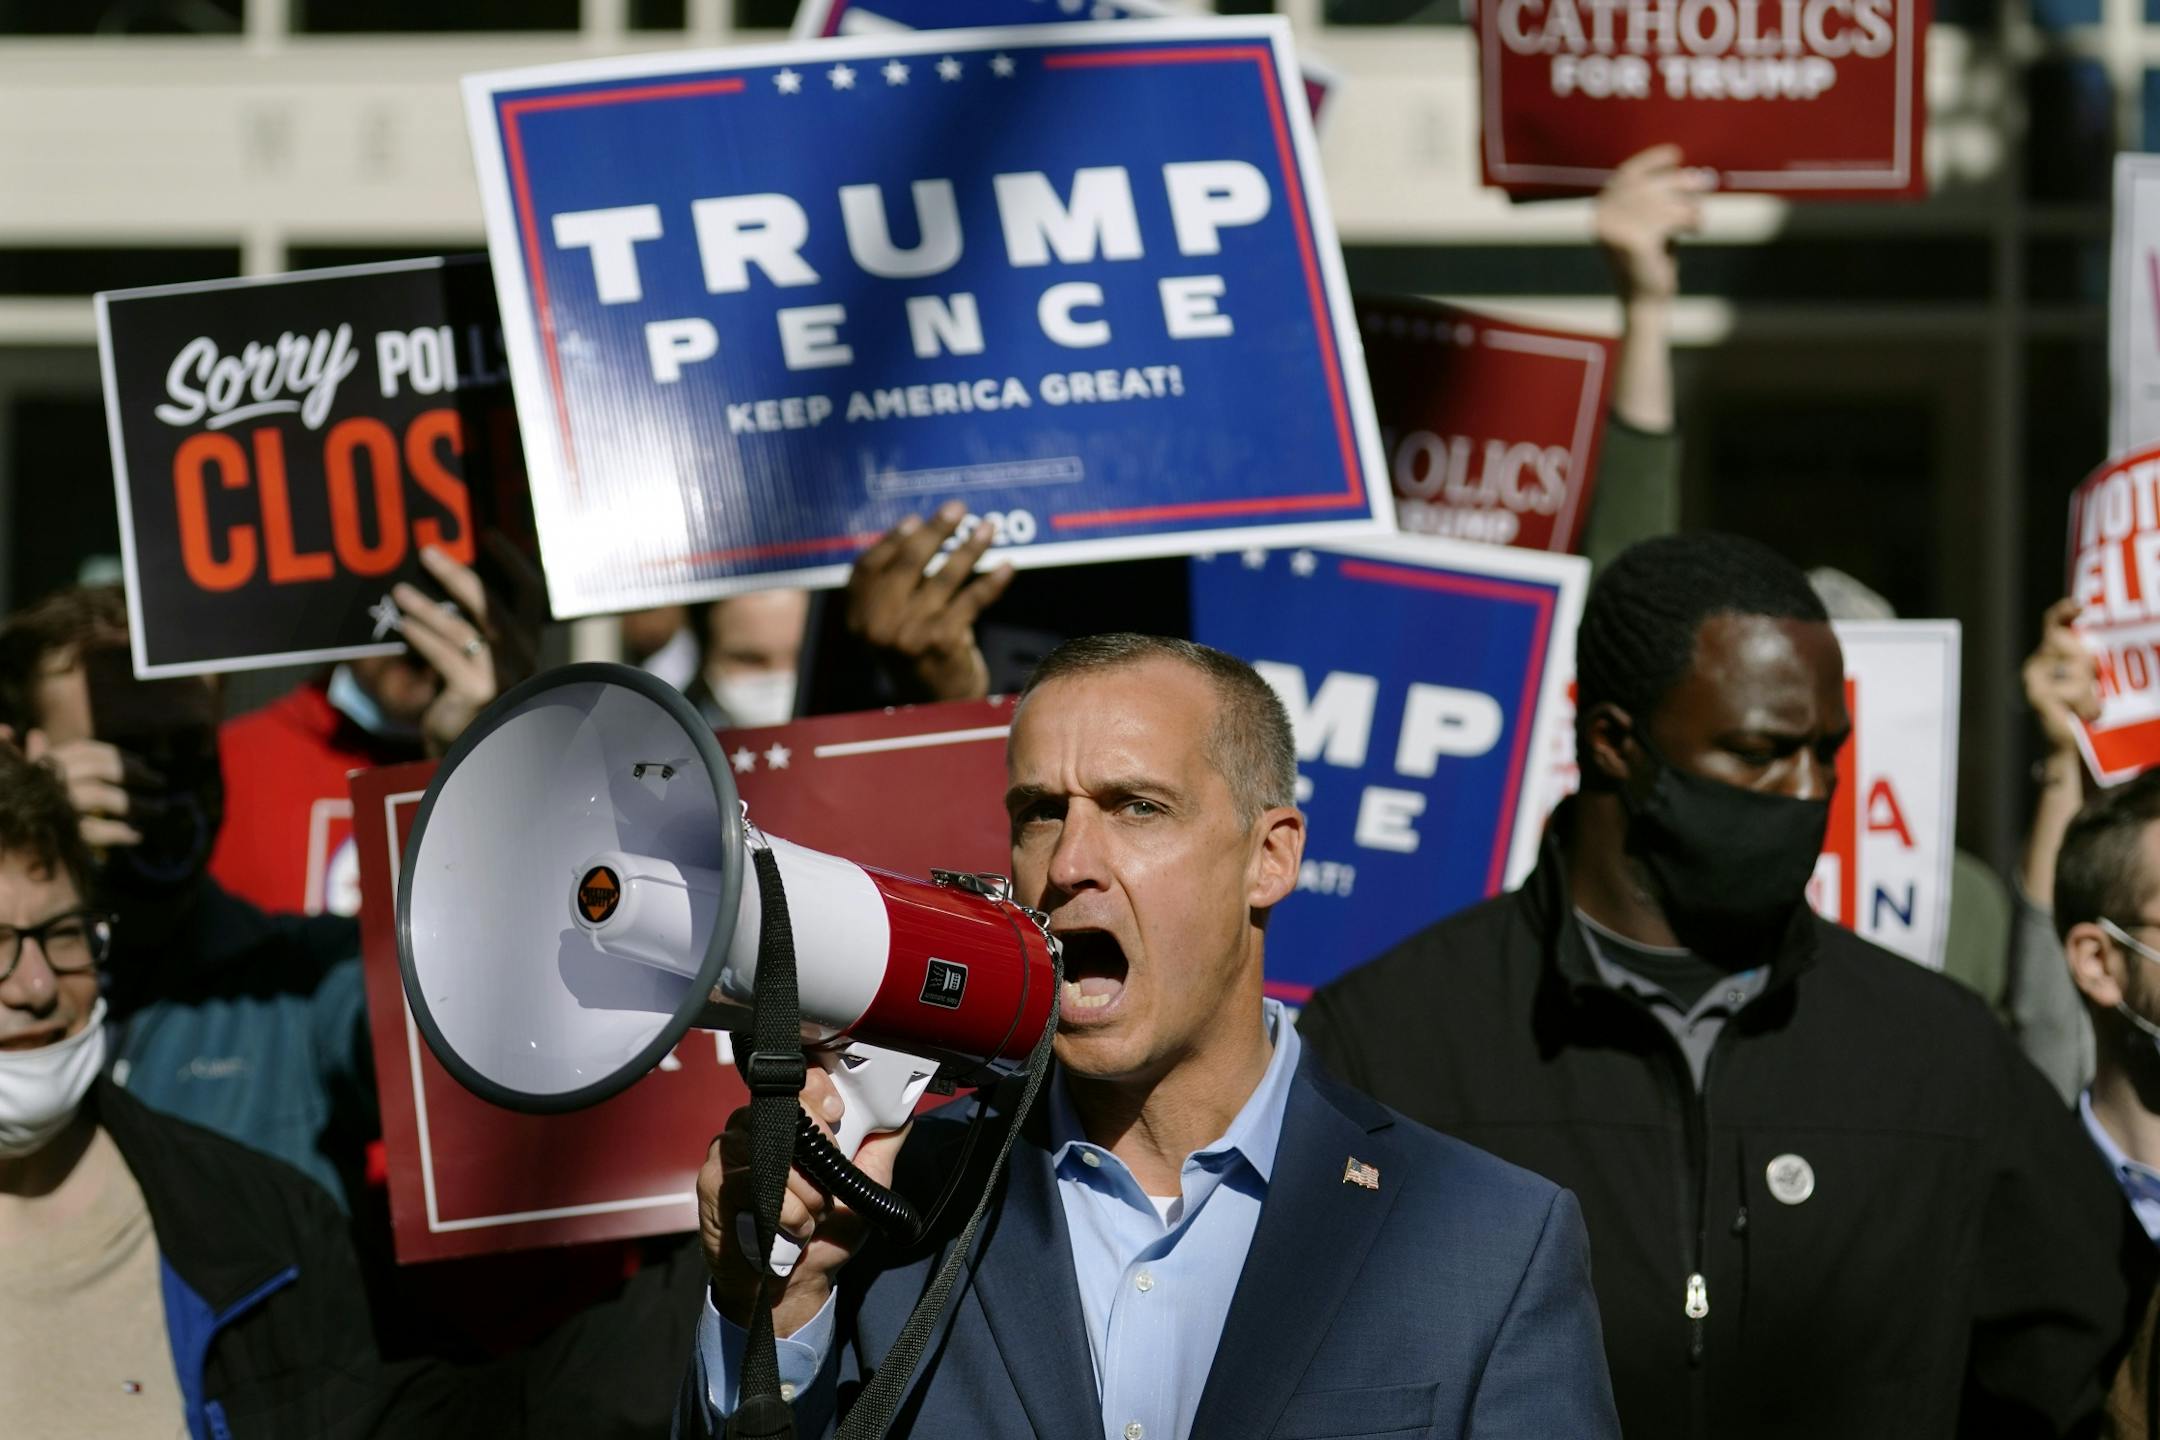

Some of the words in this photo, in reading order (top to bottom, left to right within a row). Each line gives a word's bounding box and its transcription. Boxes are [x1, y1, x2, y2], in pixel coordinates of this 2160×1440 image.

[1499, 0, 1893, 58] CATHOLICS
[1550, 54, 1651, 98] FOR
[1658, 55, 1837, 100] TRUMP
[552, 160, 1271, 304] TRUMP
[644, 275, 1234, 383] PENCE
[155, 322, 359, 430] Sorry
[376, 325, 512, 399] POLL
[727, 394, 833, 434] KEEP
[846, 377, 1032, 423] AMERICA
[1039, 364, 1185, 406] GREAT!
[1388, 430, 1571, 515] OLICS
